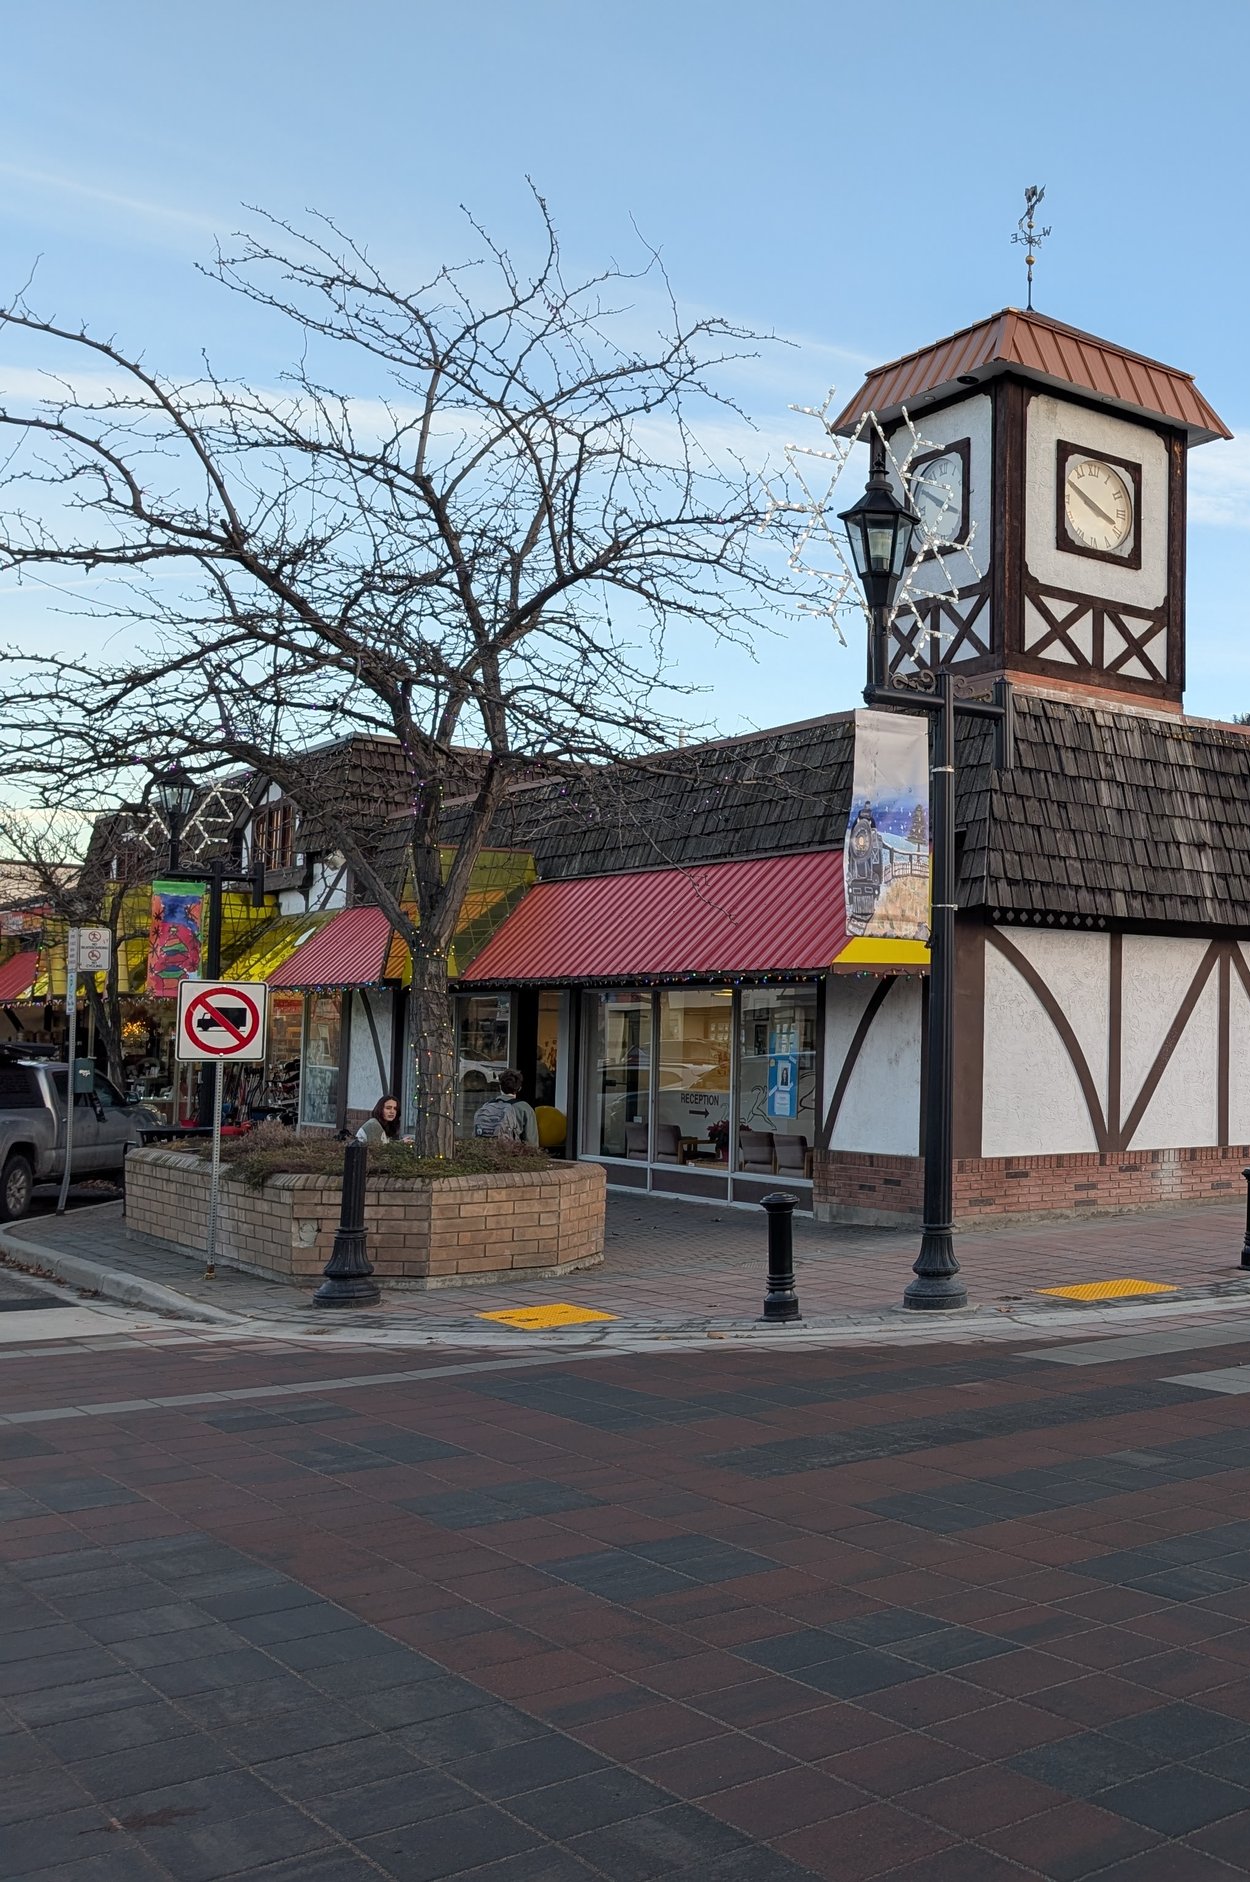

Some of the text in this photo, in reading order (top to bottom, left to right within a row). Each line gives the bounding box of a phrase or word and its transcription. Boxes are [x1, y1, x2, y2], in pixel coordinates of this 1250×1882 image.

[1088, 464, 1100, 478] XII
[1112, 491, 1123, 501] II
[1116, 509, 1126, 520] III
[1112, 526, 1122, 539] IV
[1104, 536, 1111, 548] V
[680, 1093, 720, 1106] RECEPTION
